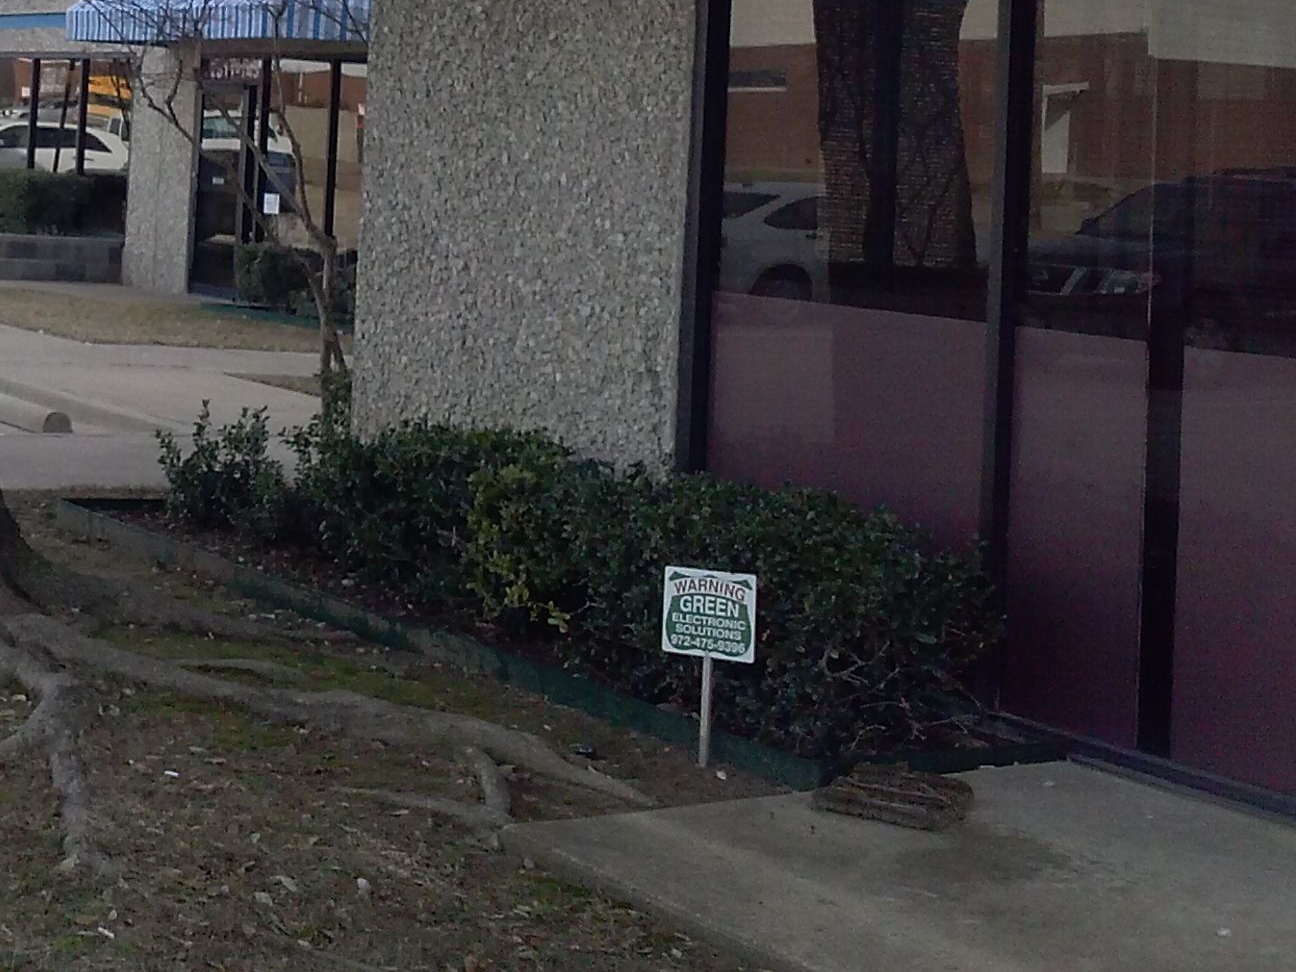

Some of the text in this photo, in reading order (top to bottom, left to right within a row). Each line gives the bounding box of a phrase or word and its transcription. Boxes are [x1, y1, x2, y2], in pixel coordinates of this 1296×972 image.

[675, 578, 745, 601] WARNING
[680, 596, 739, 617] GREEN
[673, 614, 745, 629] ELECTRONIC
[676, 624, 741, 639] SOLUTIONS
